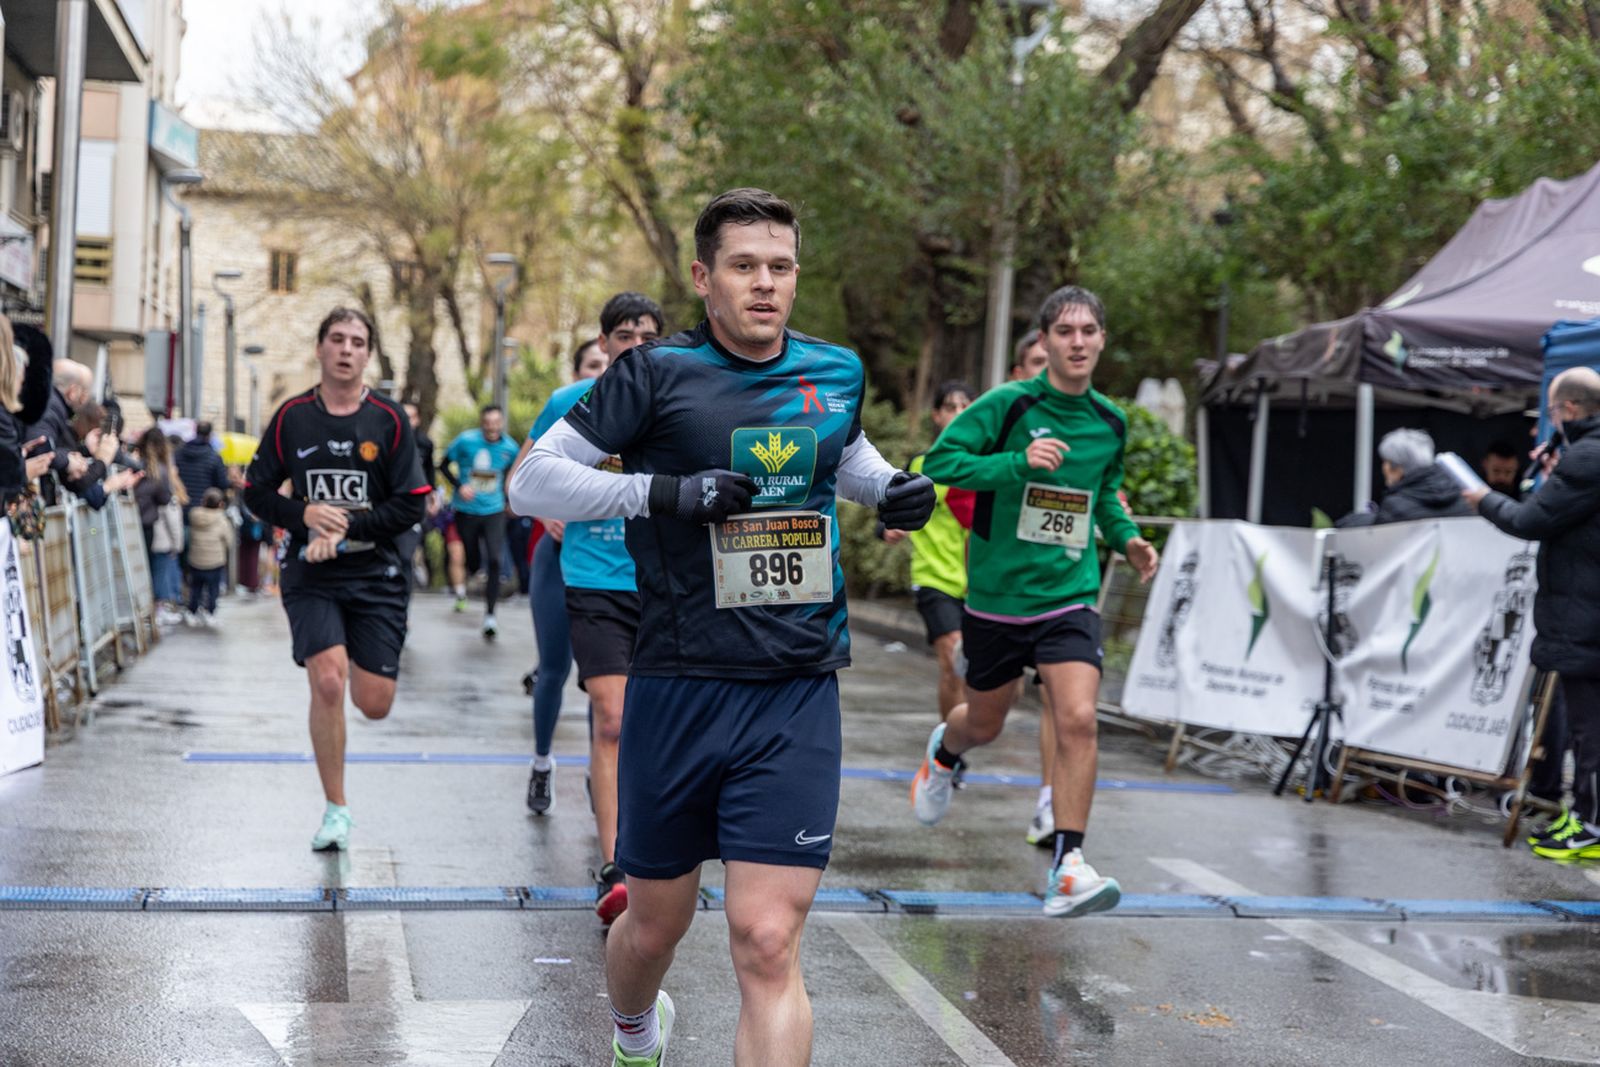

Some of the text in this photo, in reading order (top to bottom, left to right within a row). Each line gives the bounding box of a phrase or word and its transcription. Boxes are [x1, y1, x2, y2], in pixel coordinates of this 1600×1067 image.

[313, 474, 363, 502] AIG
[767, 475, 806, 486] RURAL
[757, 484, 786, 497] AÉN
[723, 517, 819, 534] IES San Juan Bosco
[1041, 512, 1074, 534] 268
[722, 532, 823, 550] V CARRERA POPULAR
[749, 552, 804, 587] 896
